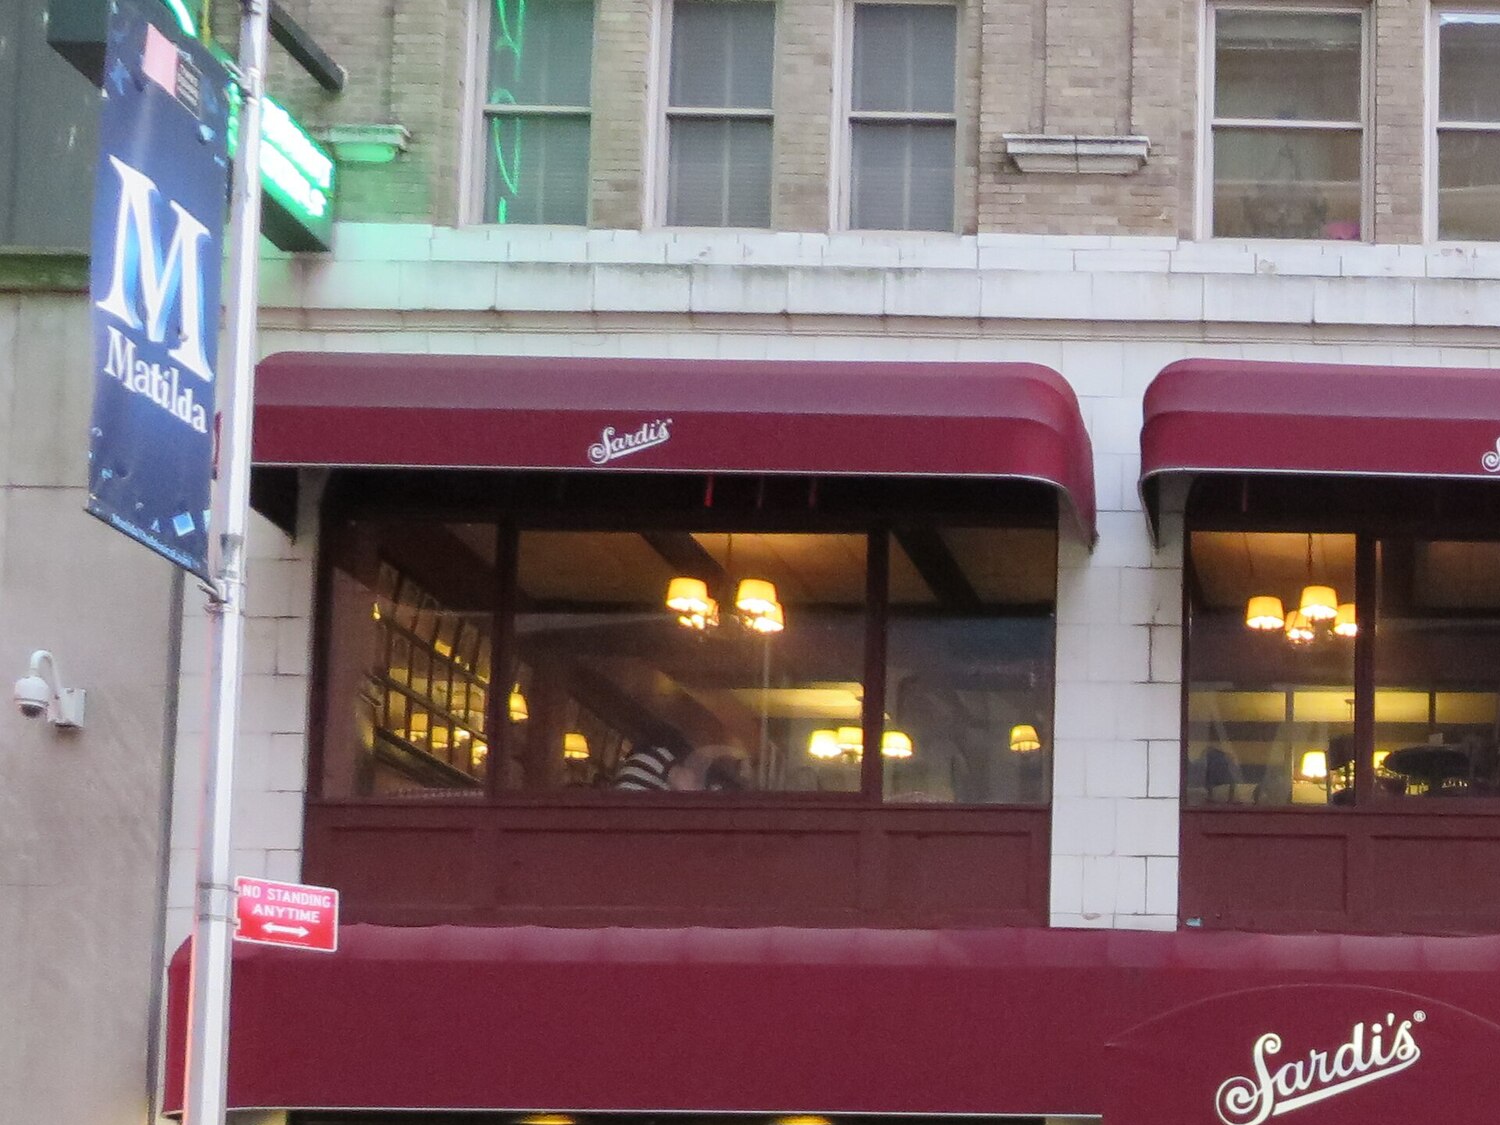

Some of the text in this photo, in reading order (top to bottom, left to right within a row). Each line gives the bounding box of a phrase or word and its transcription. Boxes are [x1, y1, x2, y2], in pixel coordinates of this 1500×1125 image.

[96, 153, 214, 382] M
[103, 325, 208, 434] Matilda
[242, 884, 331, 908] NO STANDING
[252, 903, 321, 923] ANYTIME
